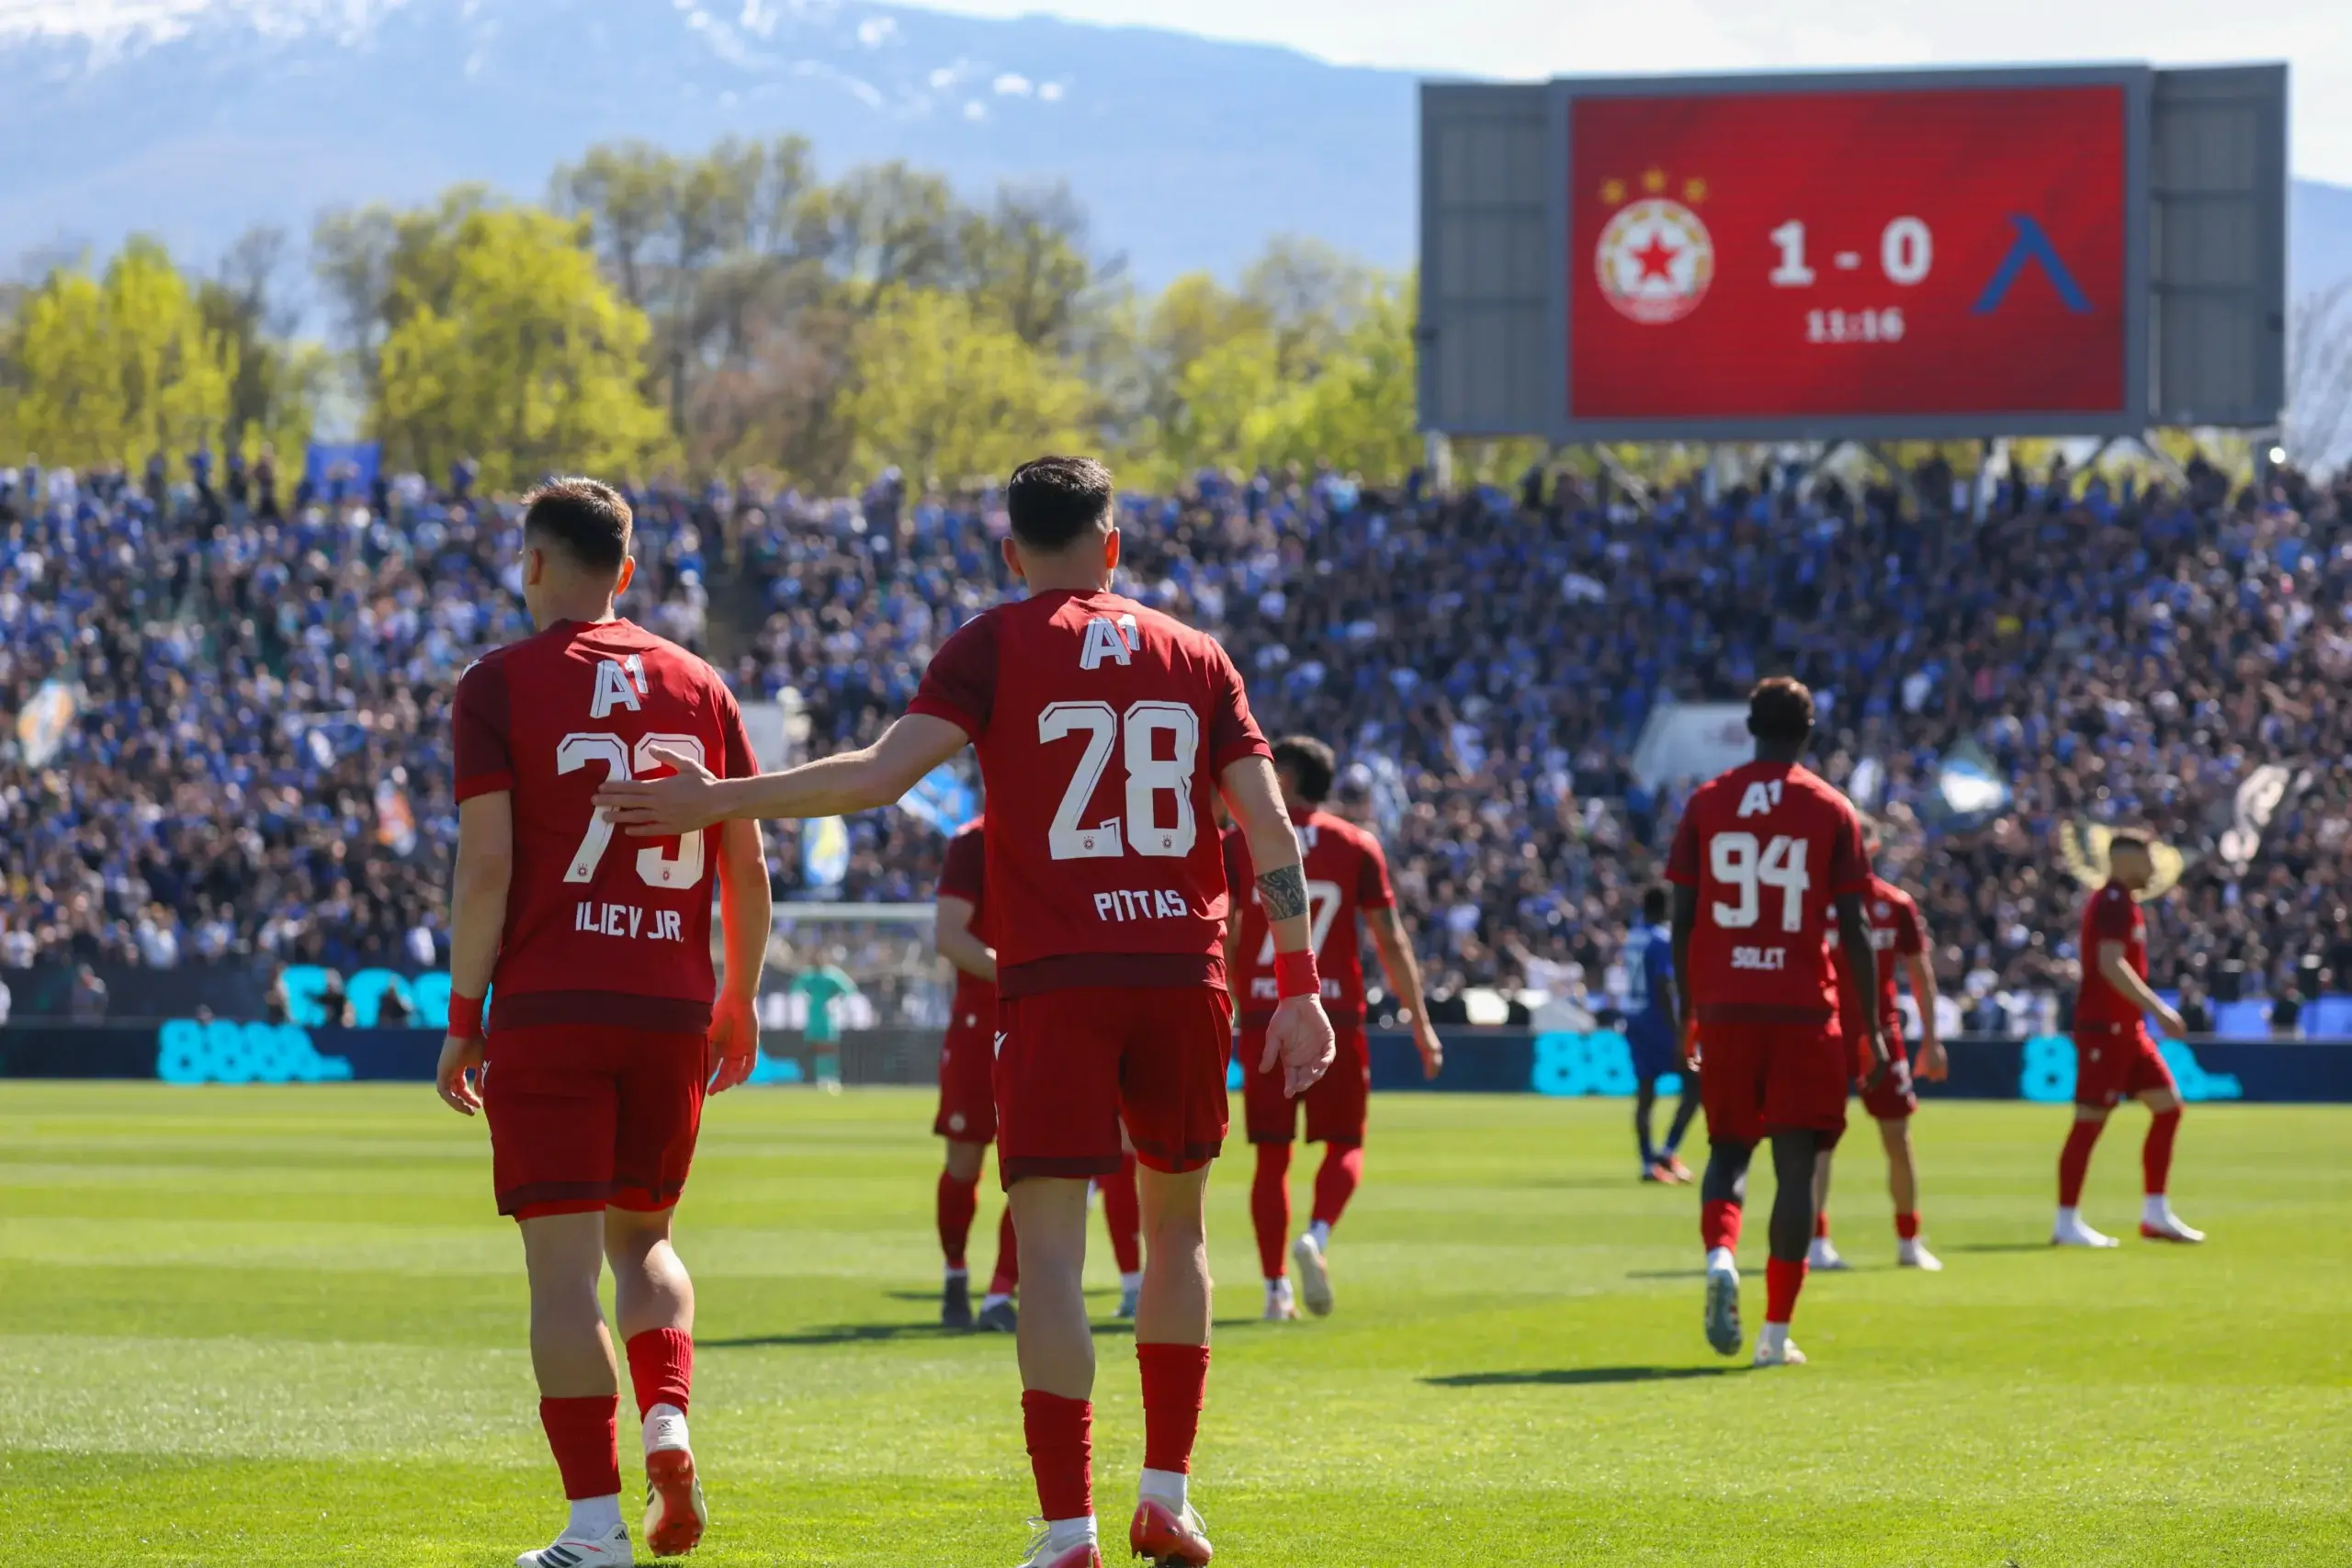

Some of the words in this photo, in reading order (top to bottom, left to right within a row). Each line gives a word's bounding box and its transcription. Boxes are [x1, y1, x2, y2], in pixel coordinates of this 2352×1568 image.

[1768, 219, 1817, 288] 1
[1880, 215, 1934, 287] 0
[1079, 613, 1140, 671] A1
[590, 653, 649, 718] A1
[1037, 699, 1200, 861] 28
[1736, 779, 1783, 818] A1
[1093, 889, 1188, 922] PITTAS
[1709, 831, 1810, 932] 94
[575, 900, 643, 940] ILIEV
